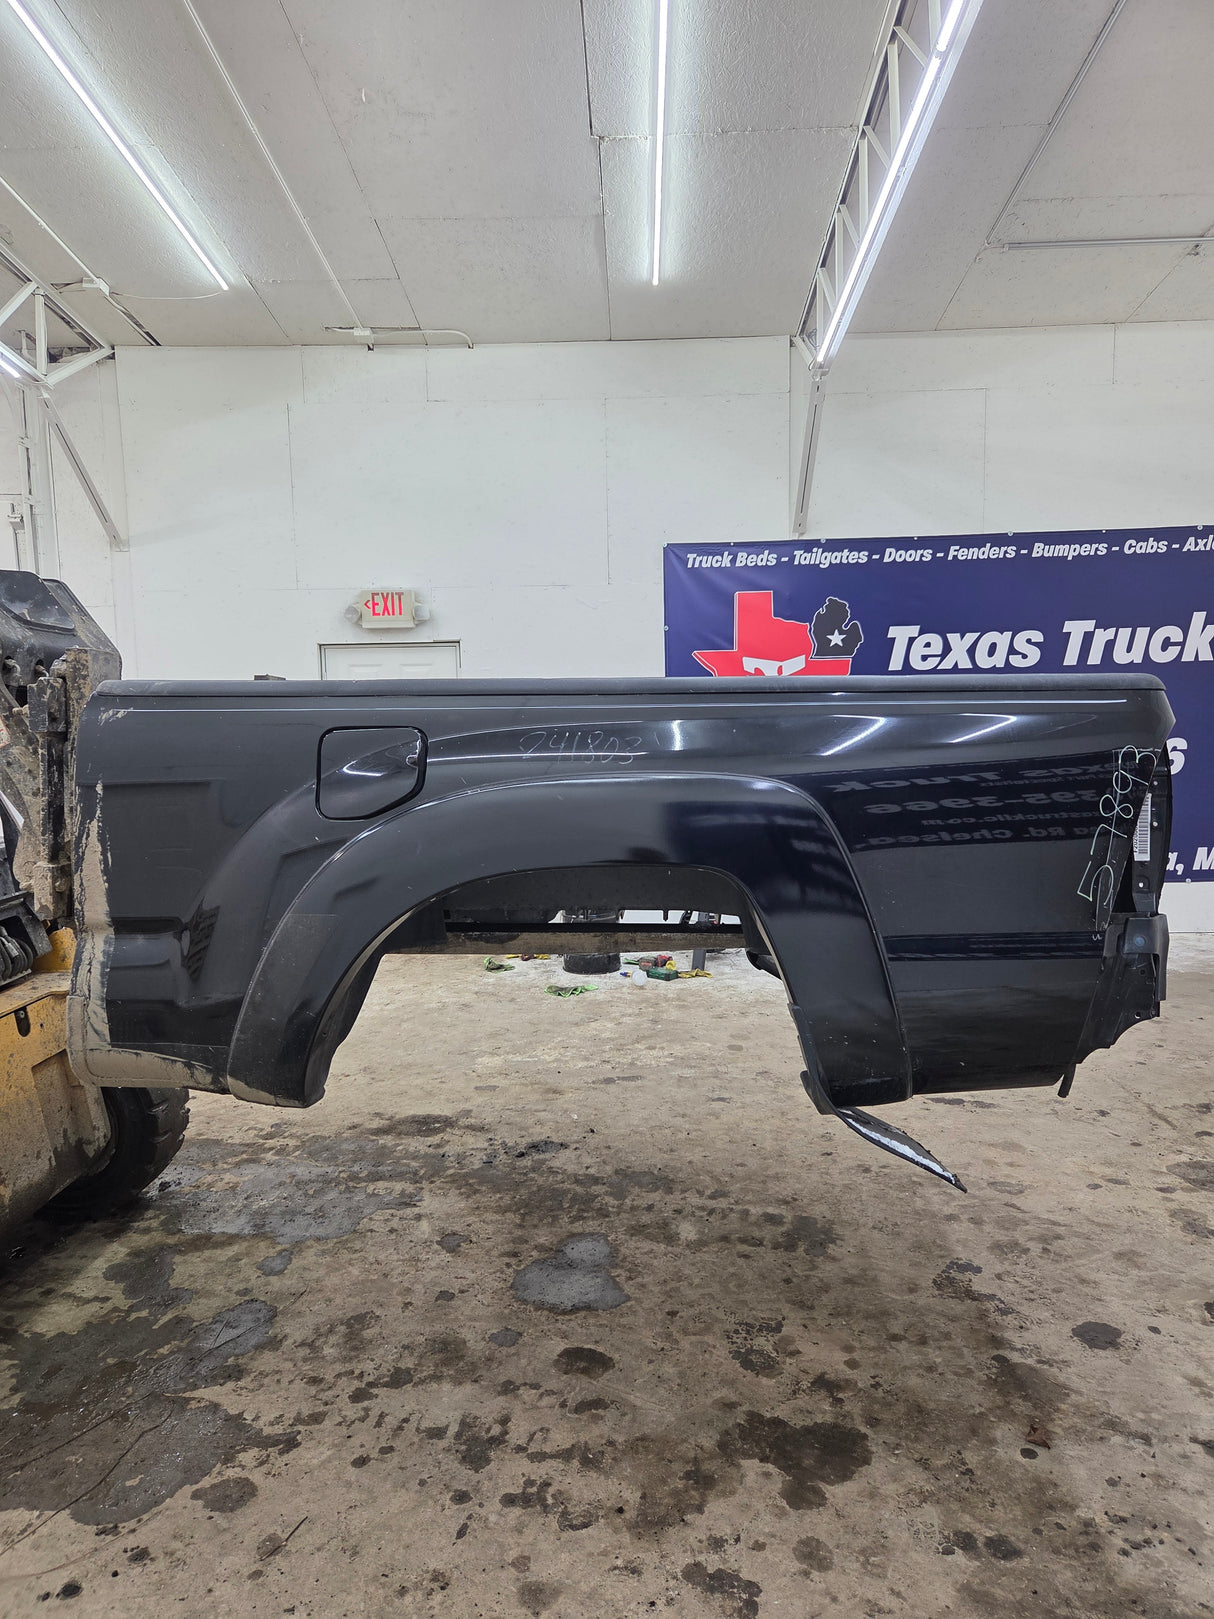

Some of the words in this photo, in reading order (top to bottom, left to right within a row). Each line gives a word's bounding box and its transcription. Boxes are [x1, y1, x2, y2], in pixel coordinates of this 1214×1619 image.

[687, 551, 732, 568] Truck
[735, 550, 777, 567] Beds
[793, 548, 868, 569] Tailgates
[883, 548, 932, 563] Doors
[948, 543, 1016, 561] Fenders
[1032, 541, 1108, 560] Bumpers
[1124, 538, 1168, 554] Cabs
[371, 591, 404, 616] EXIT
[887, 625, 1044, 671] Texas
[1062, 611, 1214, 666] Truck
[519, 731, 642, 765] 241803
[1077, 744, 1157, 906] 57893
